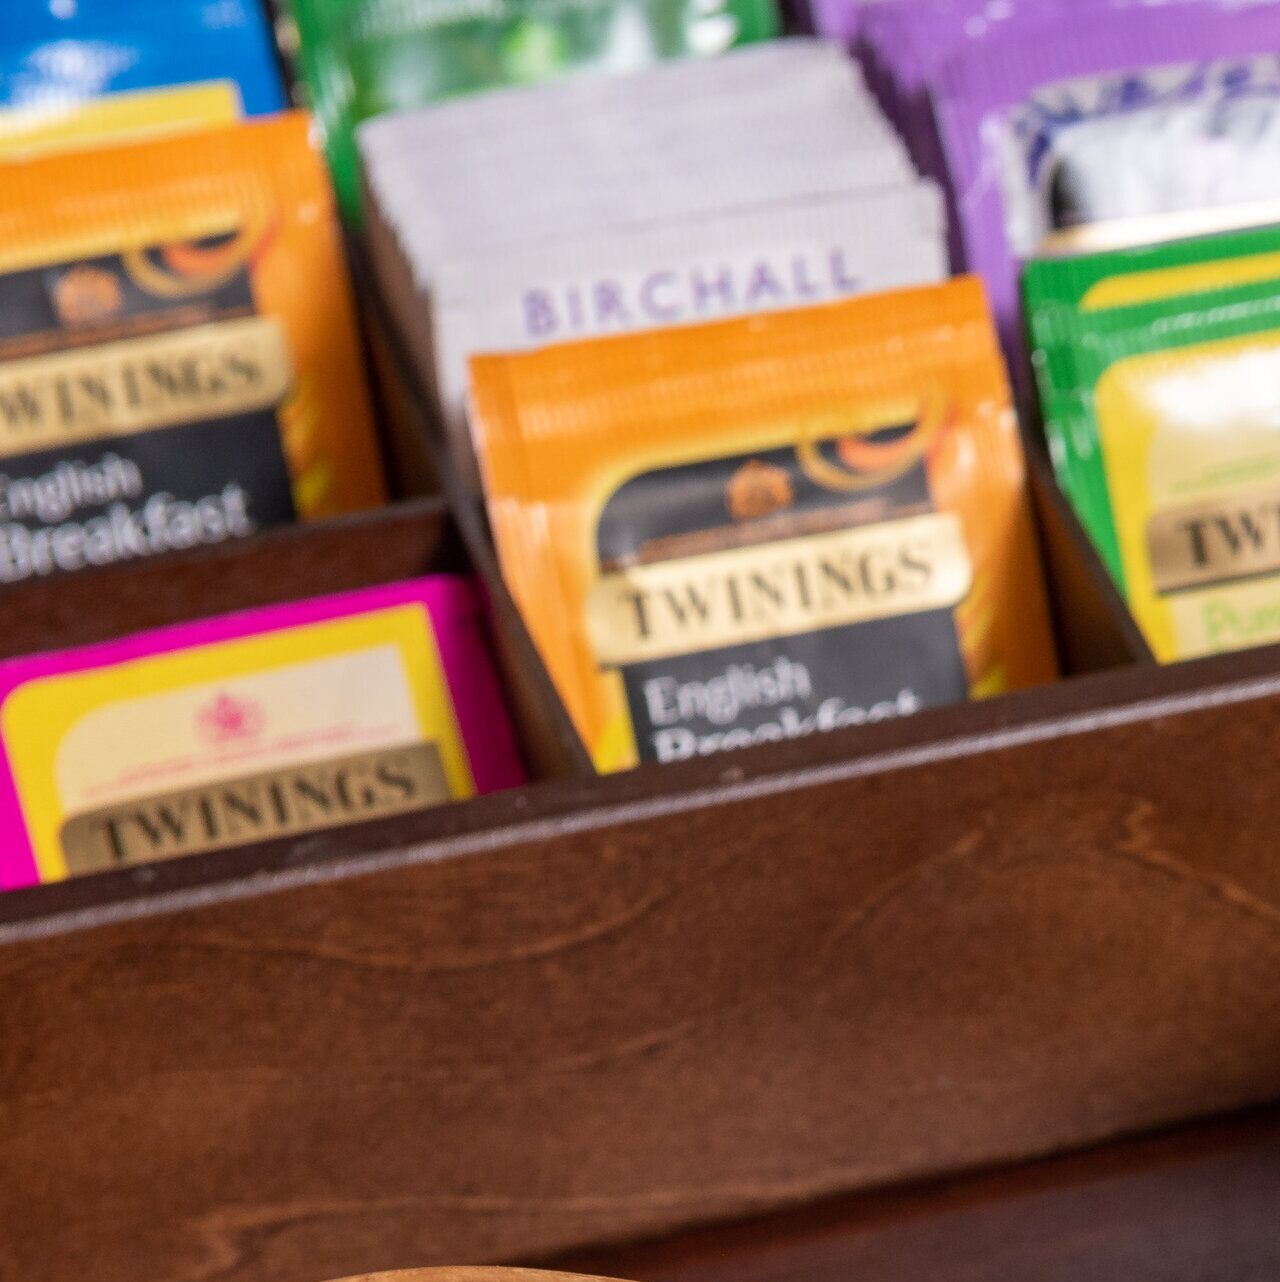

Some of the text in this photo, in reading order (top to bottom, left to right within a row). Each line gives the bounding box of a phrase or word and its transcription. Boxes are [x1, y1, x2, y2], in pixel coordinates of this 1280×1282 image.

[521, 247, 862, 338] BIRCHALL
[0, 350, 263, 428] WININGS
[0, 450, 143, 524] nglish
[619, 549, 936, 642] TWININGS
[645, 654, 812, 726] English
[101, 763, 416, 860] TWININGS
